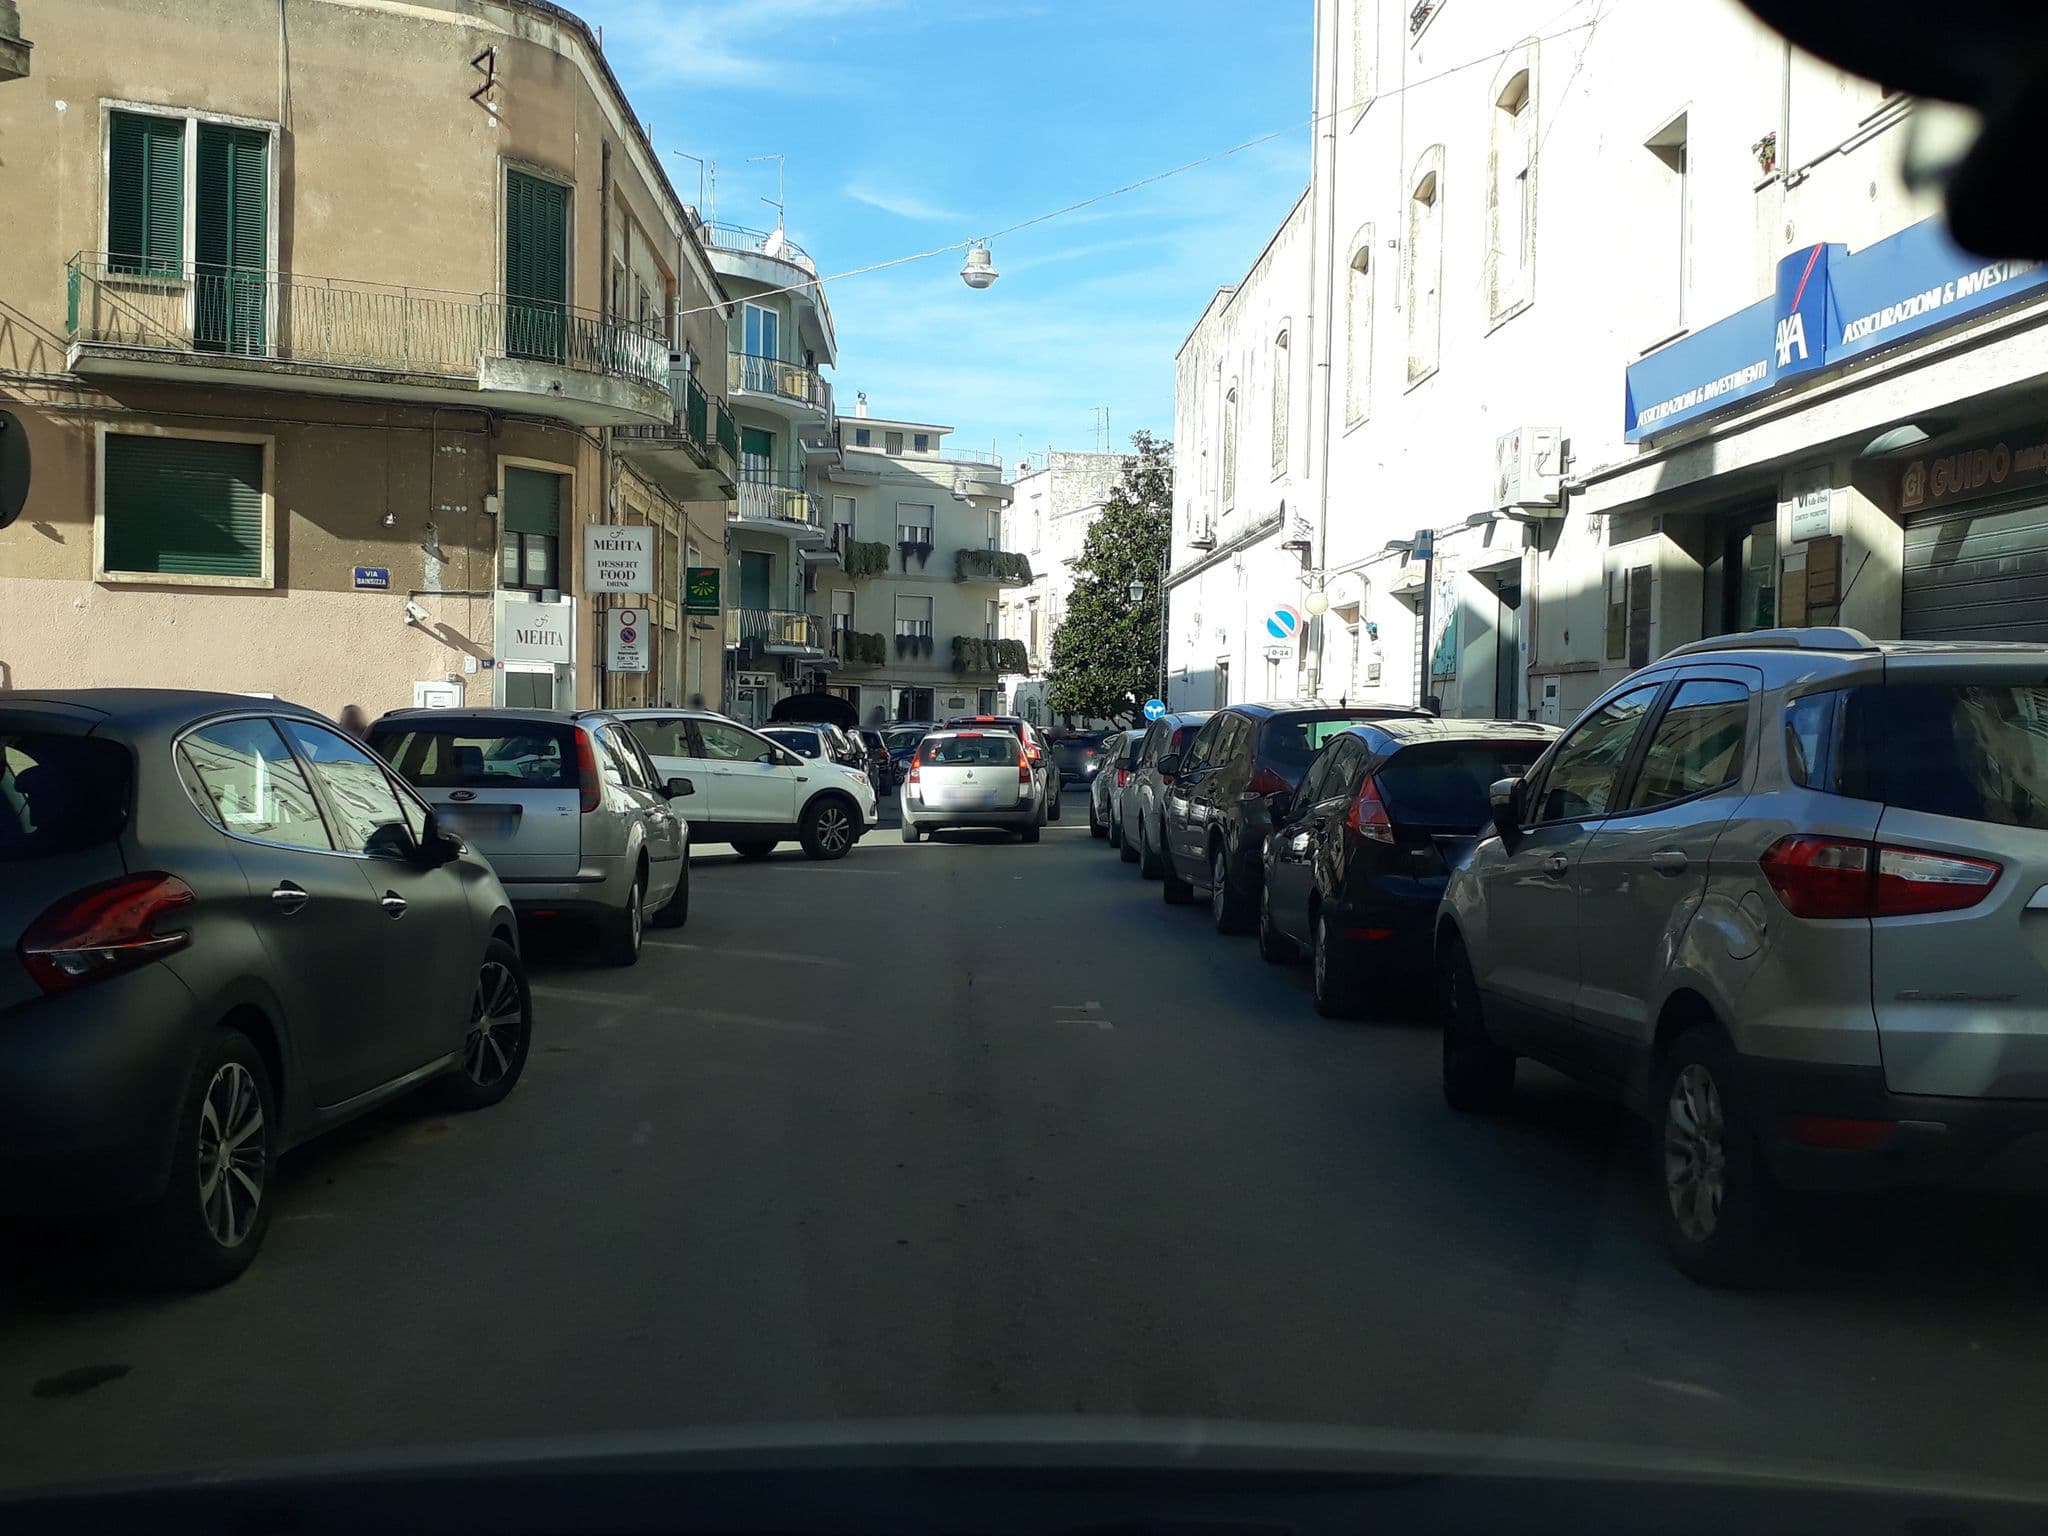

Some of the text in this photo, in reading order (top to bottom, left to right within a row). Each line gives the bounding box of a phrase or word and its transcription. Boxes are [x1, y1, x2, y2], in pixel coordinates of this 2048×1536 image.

[1841, 286, 1942, 345] ASSICURAZIONI
[1942, 281, 1956, 305] &
[1775, 311, 1809, 369] AXA
[1636, 359, 1768, 428] ASSICURAZIONI & INVESTIMENTI
[1930, 442, 2011, 497] GUIDO
[593, 539, 642, 551] MEHTA
[597, 560, 639, 568] DESSERT
[600, 569, 636, 580] FOOD
[515, 629, 563, 646] MEHTA
